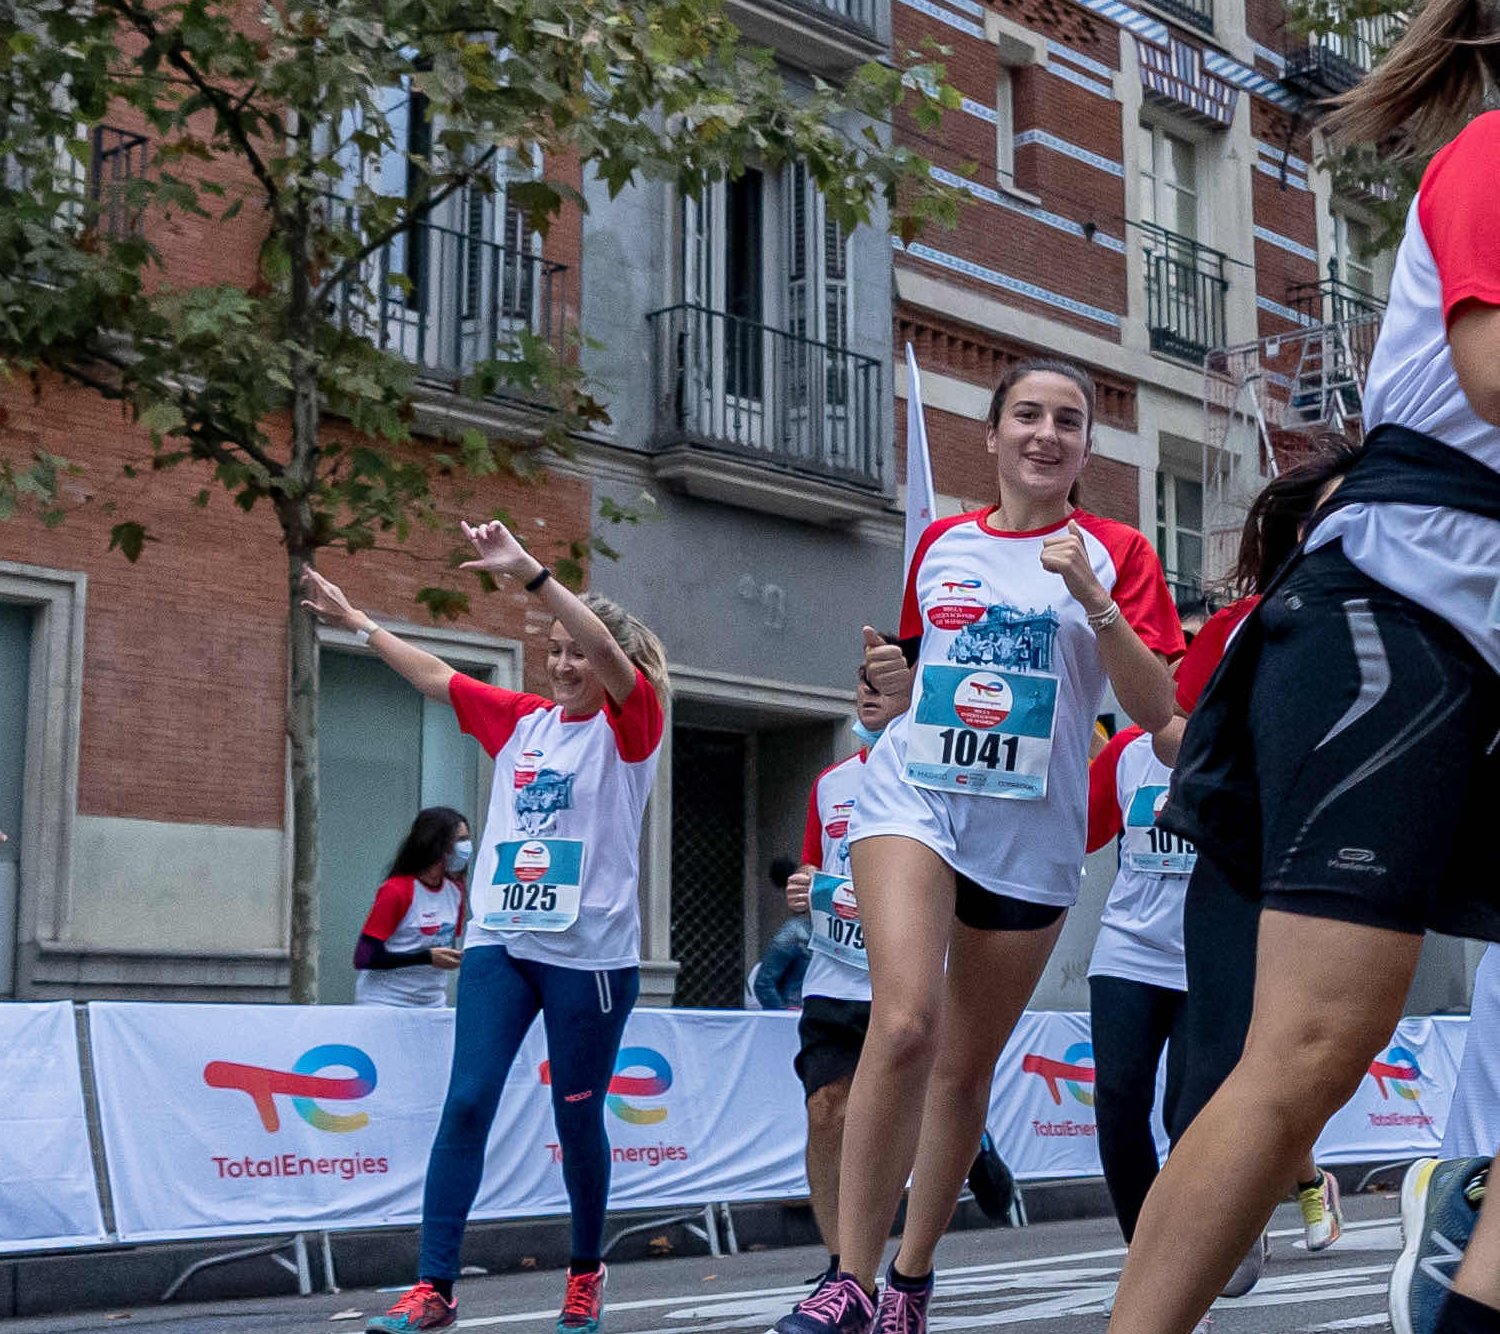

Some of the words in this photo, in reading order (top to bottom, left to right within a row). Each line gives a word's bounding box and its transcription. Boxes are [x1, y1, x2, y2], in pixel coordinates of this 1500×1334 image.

[940, 728, 1019, 771] 1041
[501, 883, 557, 912] 1025
[212, 1151, 388, 1181] TotalEnergies
